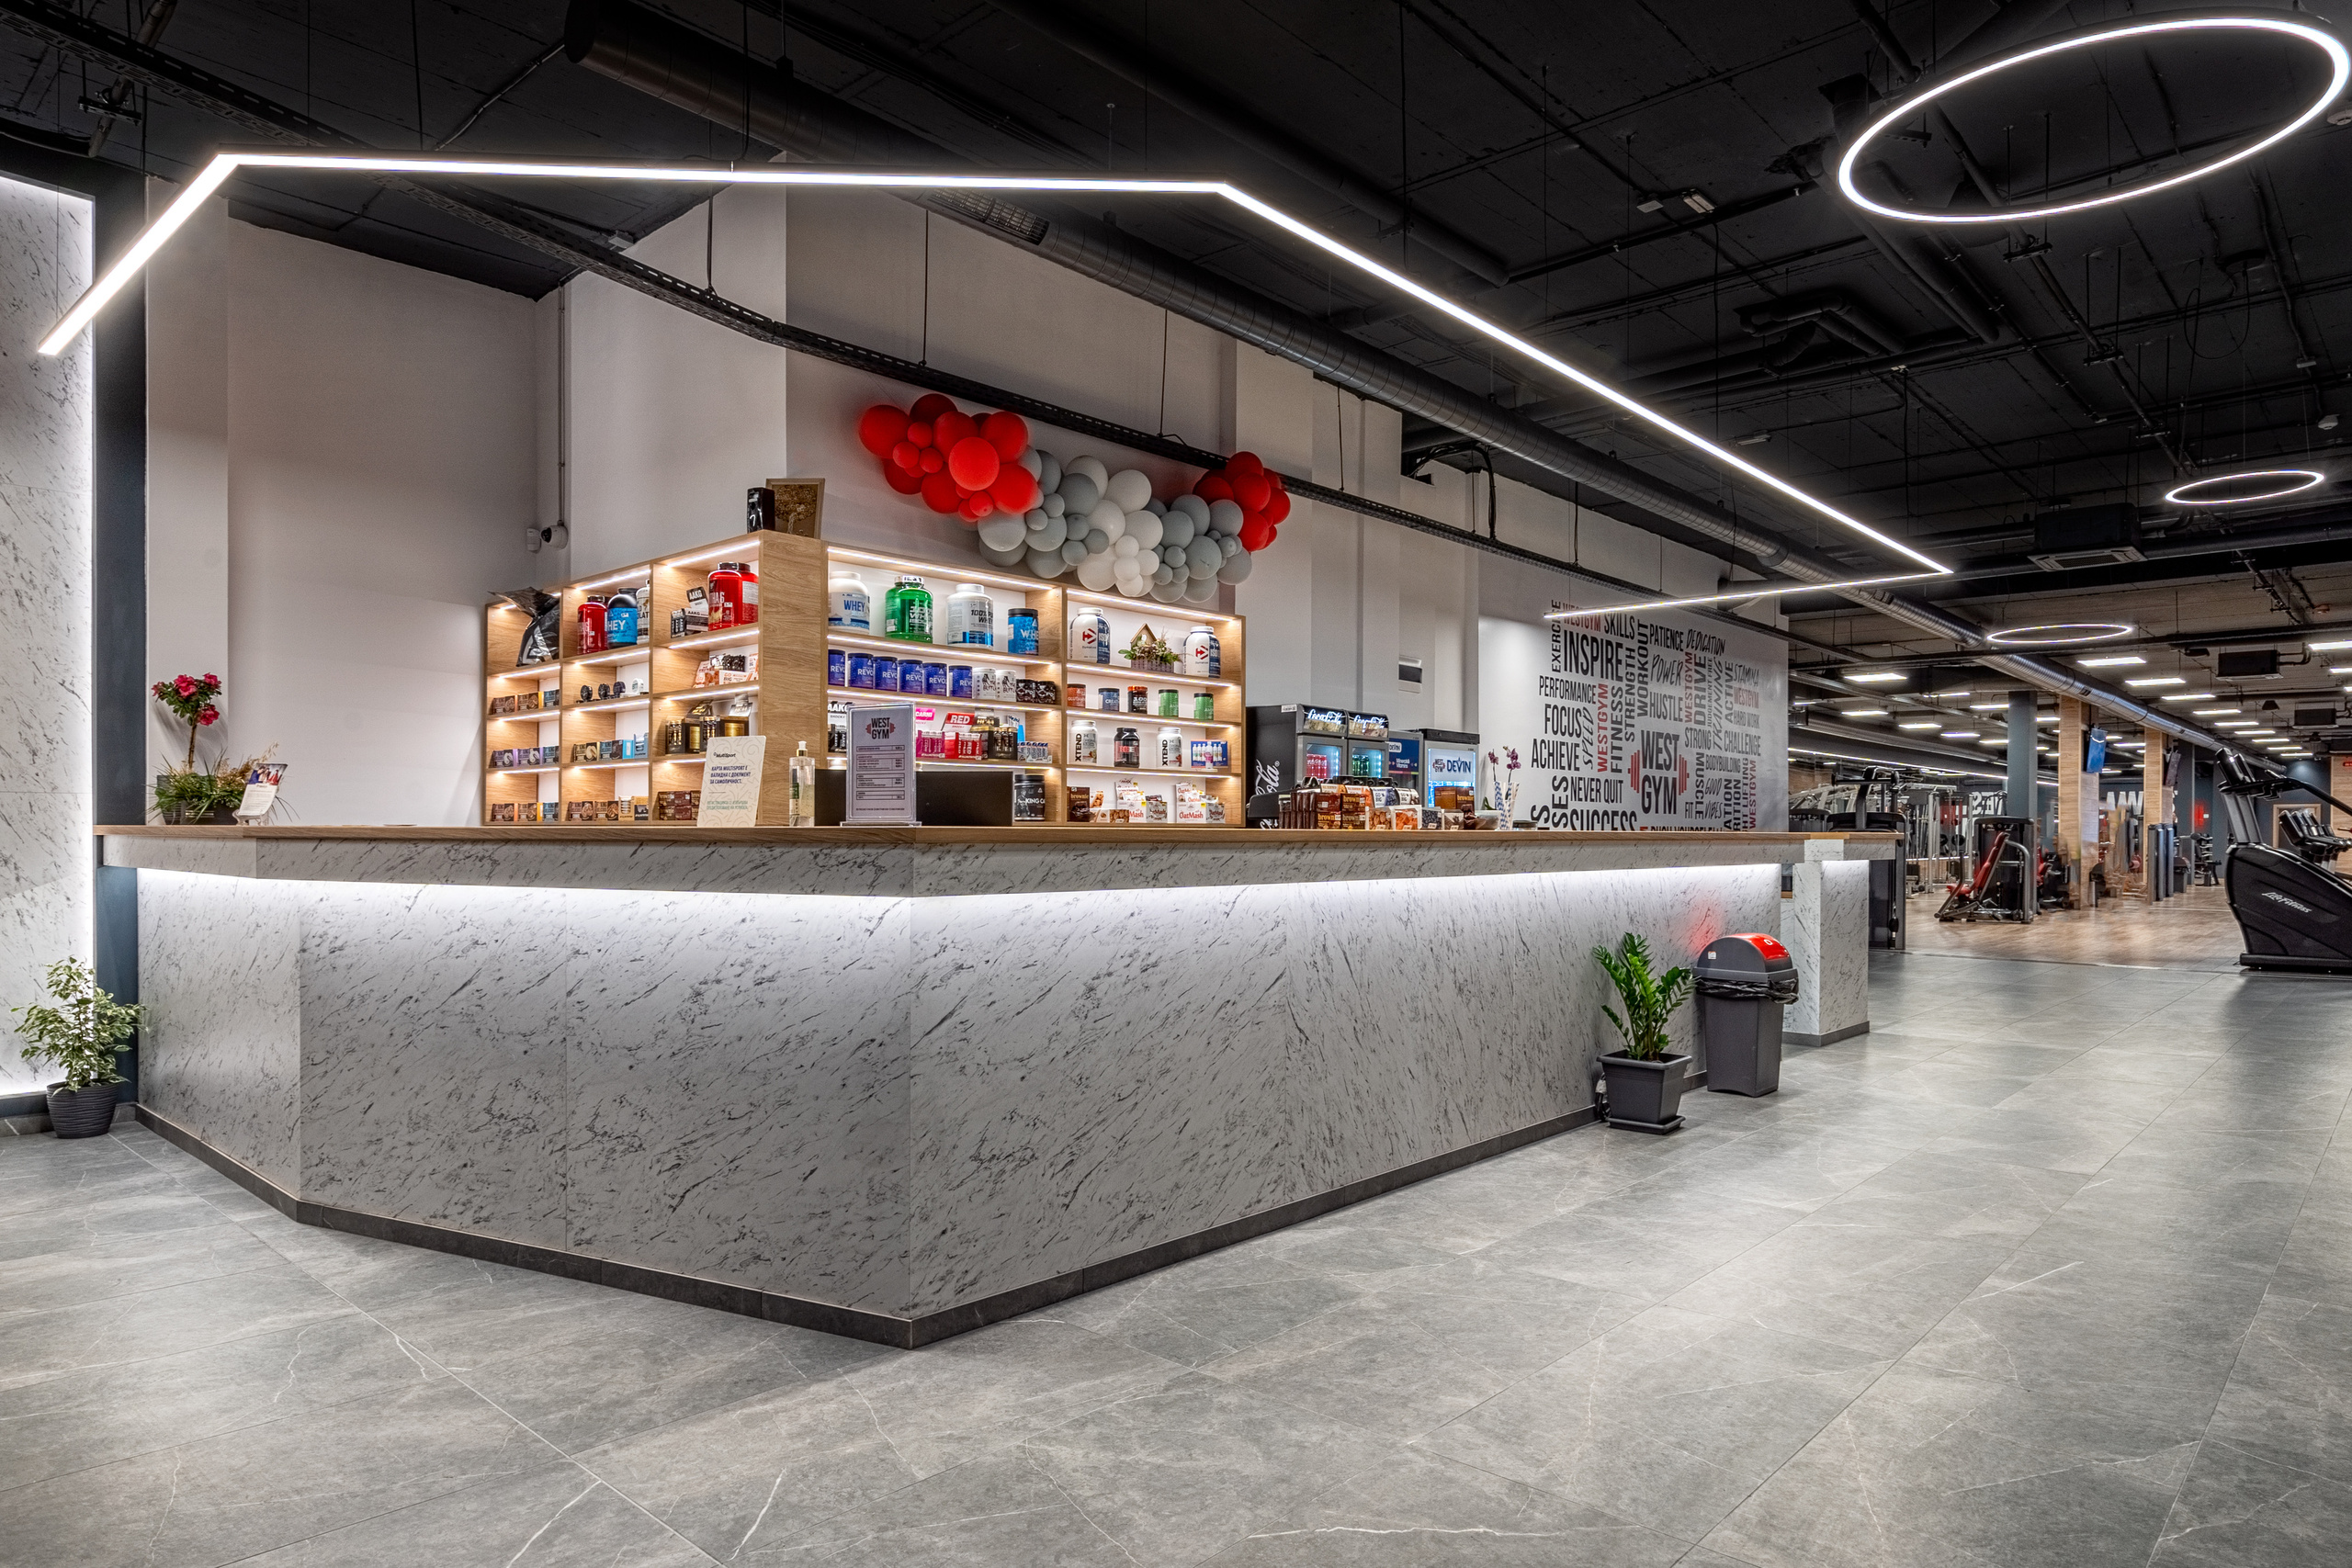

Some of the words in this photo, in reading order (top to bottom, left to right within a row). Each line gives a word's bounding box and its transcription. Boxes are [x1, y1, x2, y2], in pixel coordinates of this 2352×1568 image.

[689, 589, 703, 601] AAKG
[843, 599, 865, 613] WHEY
[1551, 599, 1562, 673] EXERCIE
[1604, 612, 1635, 640] SKILLS
[1649, 623, 1684, 652] PATIENCE
[1564, 629, 1623, 682] INSPIRE
[1686, 628, 1725, 657] DEDICATION
[1636, 618, 1649, 717] WORKOUT
[1650, 653, 1684, 686] POWER
[1539, 675, 1597, 705] PERFORMANCE
[1624, 647, 1636, 742] STRENGTH
[1684, 651, 1693, 724] WESTGYM
[1693, 653, 1707, 726] DRIVE
[1724, 660, 1734, 724] ACTIVE
[950, 715, 970, 724] RED
[1649, 692, 1683, 723] HUSTLE
[1713, 657, 1723, 751] TRAINING
[871, 717, 890, 728] WEST
[871, 729, 890, 739] GYM
[1544, 703, 1582, 739] FOCUS
[1597, 682, 1609, 773] WESTGYM
[1611, 685, 1623, 773] FITNESS
[1582, 706, 1594, 770] SPEED
[1641, 729, 1680, 772] WEST
[1685, 727, 1712, 750] STRONG
[1724, 729, 1761, 757] CHALLENGE
[1446, 758, 1472, 773] DEVIN
[1531, 738, 1580, 772] ACHIEVE
[1705, 753, 1741, 773] BODYBUILDING
[1570, 776, 1601, 803] NEVER
[1603, 778, 1623, 805] QUIT
[1641, 774, 1678, 815] GYM
[1694, 751, 1705, 820] MUSCLE
[1705, 777, 1723, 796] GOOD
[1748, 760, 1757, 829] WESTGYM
[1179, 811, 1204, 819] OatMash
[1684, 801, 1694, 819] FIT
